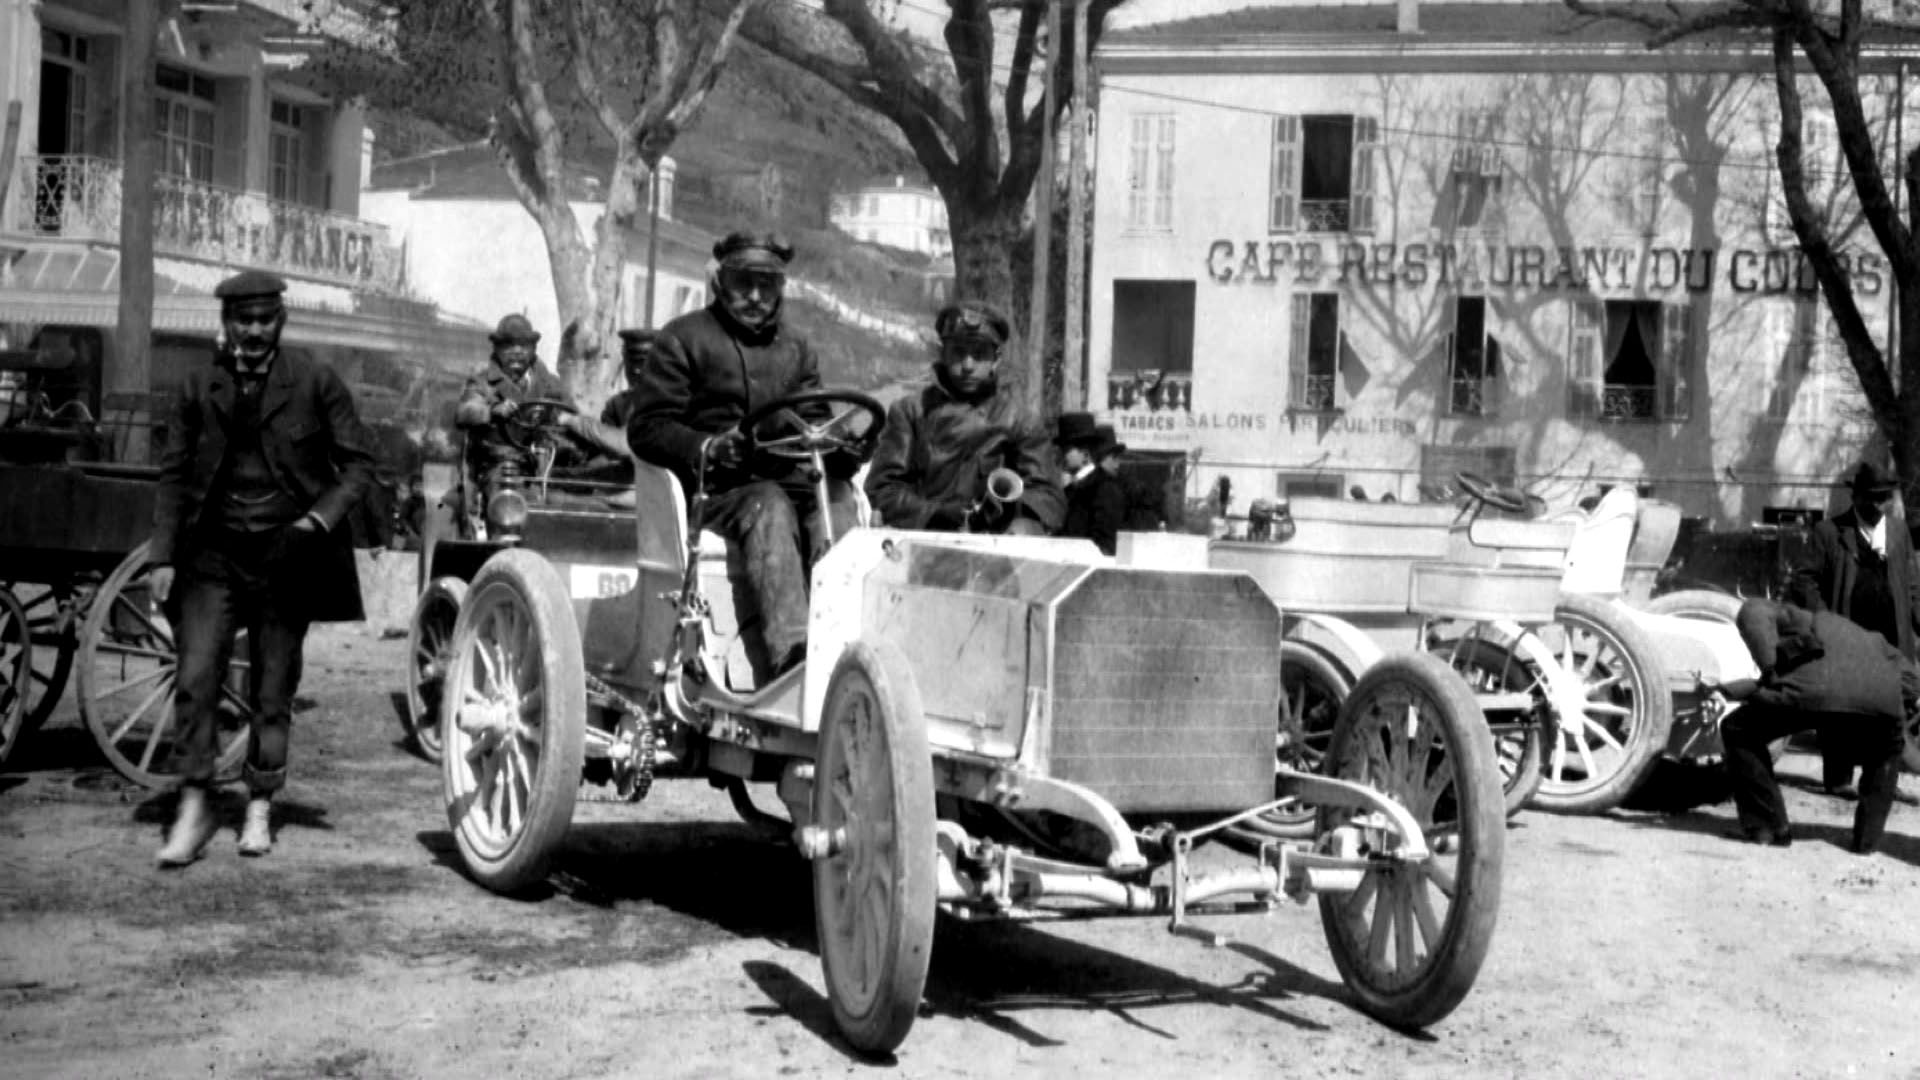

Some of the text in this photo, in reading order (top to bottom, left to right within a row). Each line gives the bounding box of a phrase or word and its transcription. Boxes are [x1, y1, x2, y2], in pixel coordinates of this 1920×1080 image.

[270, 213, 373, 278] FRANCE
[1337, 242, 1636, 290] RESTAURANT
[1651, 247, 1713, 294] DU
[1120, 415, 1175, 431] TABACS
[1185, 413, 1266, 431] SALONS
